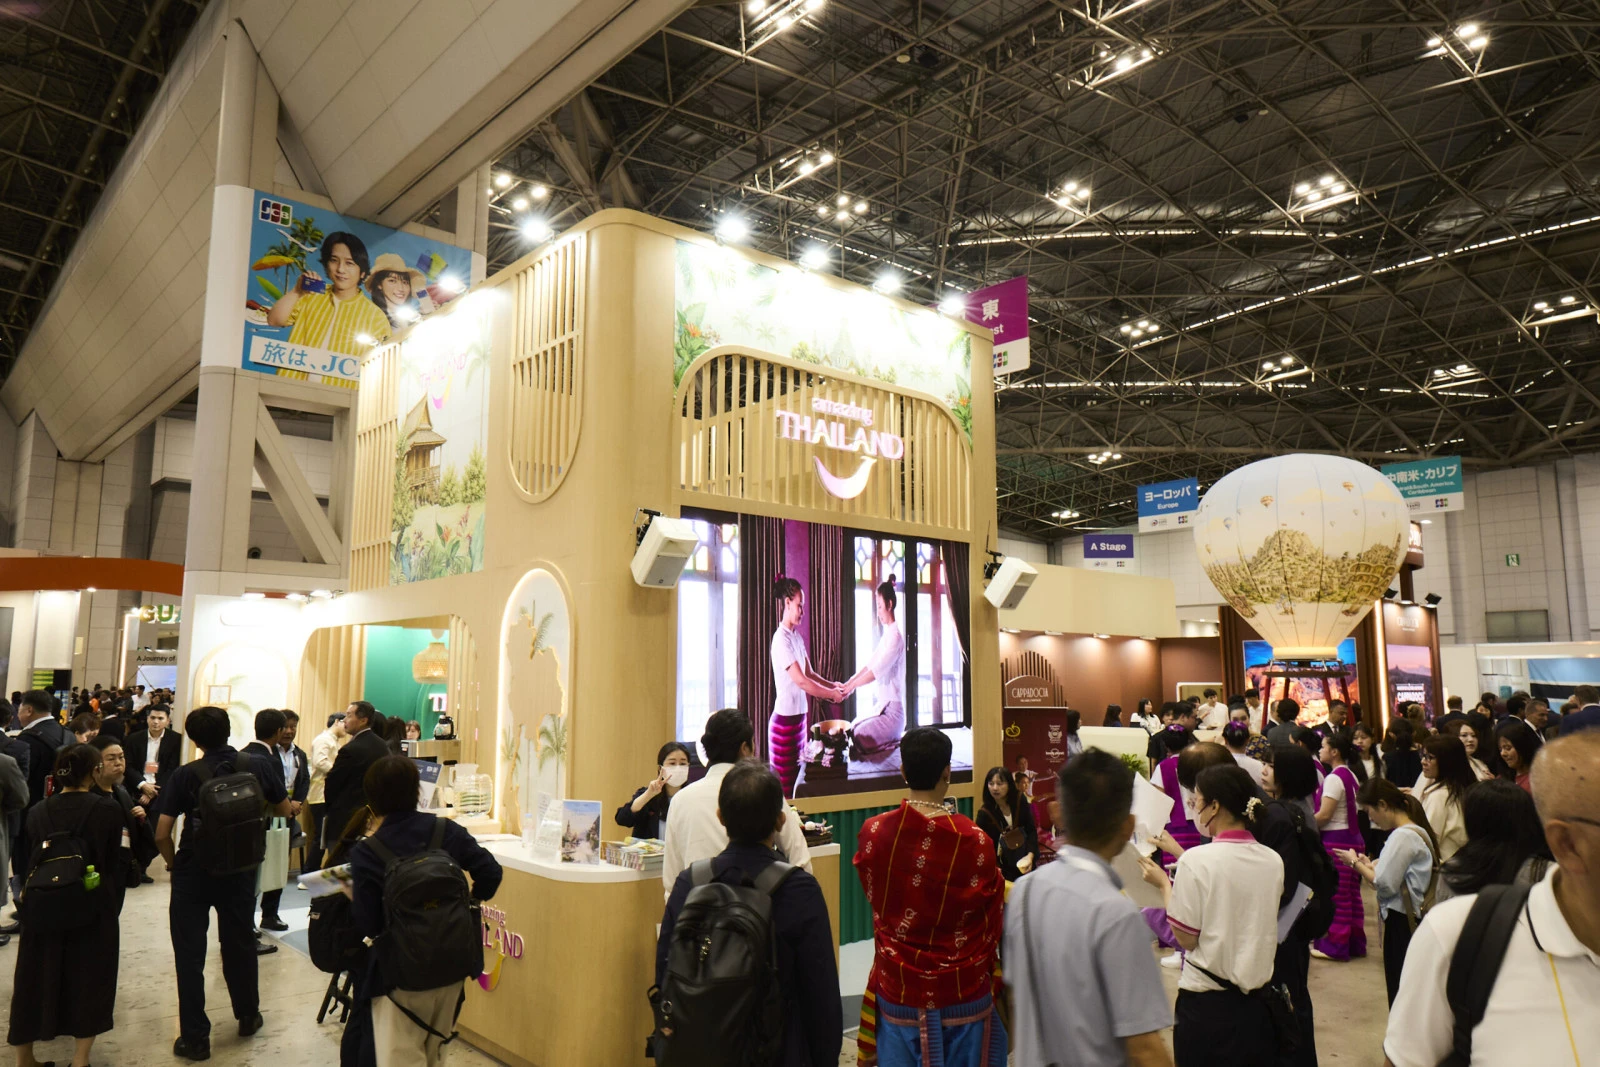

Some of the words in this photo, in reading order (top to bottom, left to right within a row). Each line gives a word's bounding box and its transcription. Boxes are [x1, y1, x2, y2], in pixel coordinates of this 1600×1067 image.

[982, 299, 999, 321] 東
[990, 323, 1004, 334] st
[261, 341, 361, 378] 旅は、JC
[812, 397, 872, 426] amazing
[776, 409, 904, 460] THAILAND
[1145, 485, 1191, 502] ヨーロッパ
[1408, 487, 1436, 495] Caribbean
[1157, 502, 1179, 510] Europe
[1090, 542, 1098, 551] A
[1100, 542, 1127, 551] Stage
[140, 604, 181, 624] GU
[1012, 687, 1048, 698] CAPPADOCIA
[481, 922, 524, 959] ILAND
